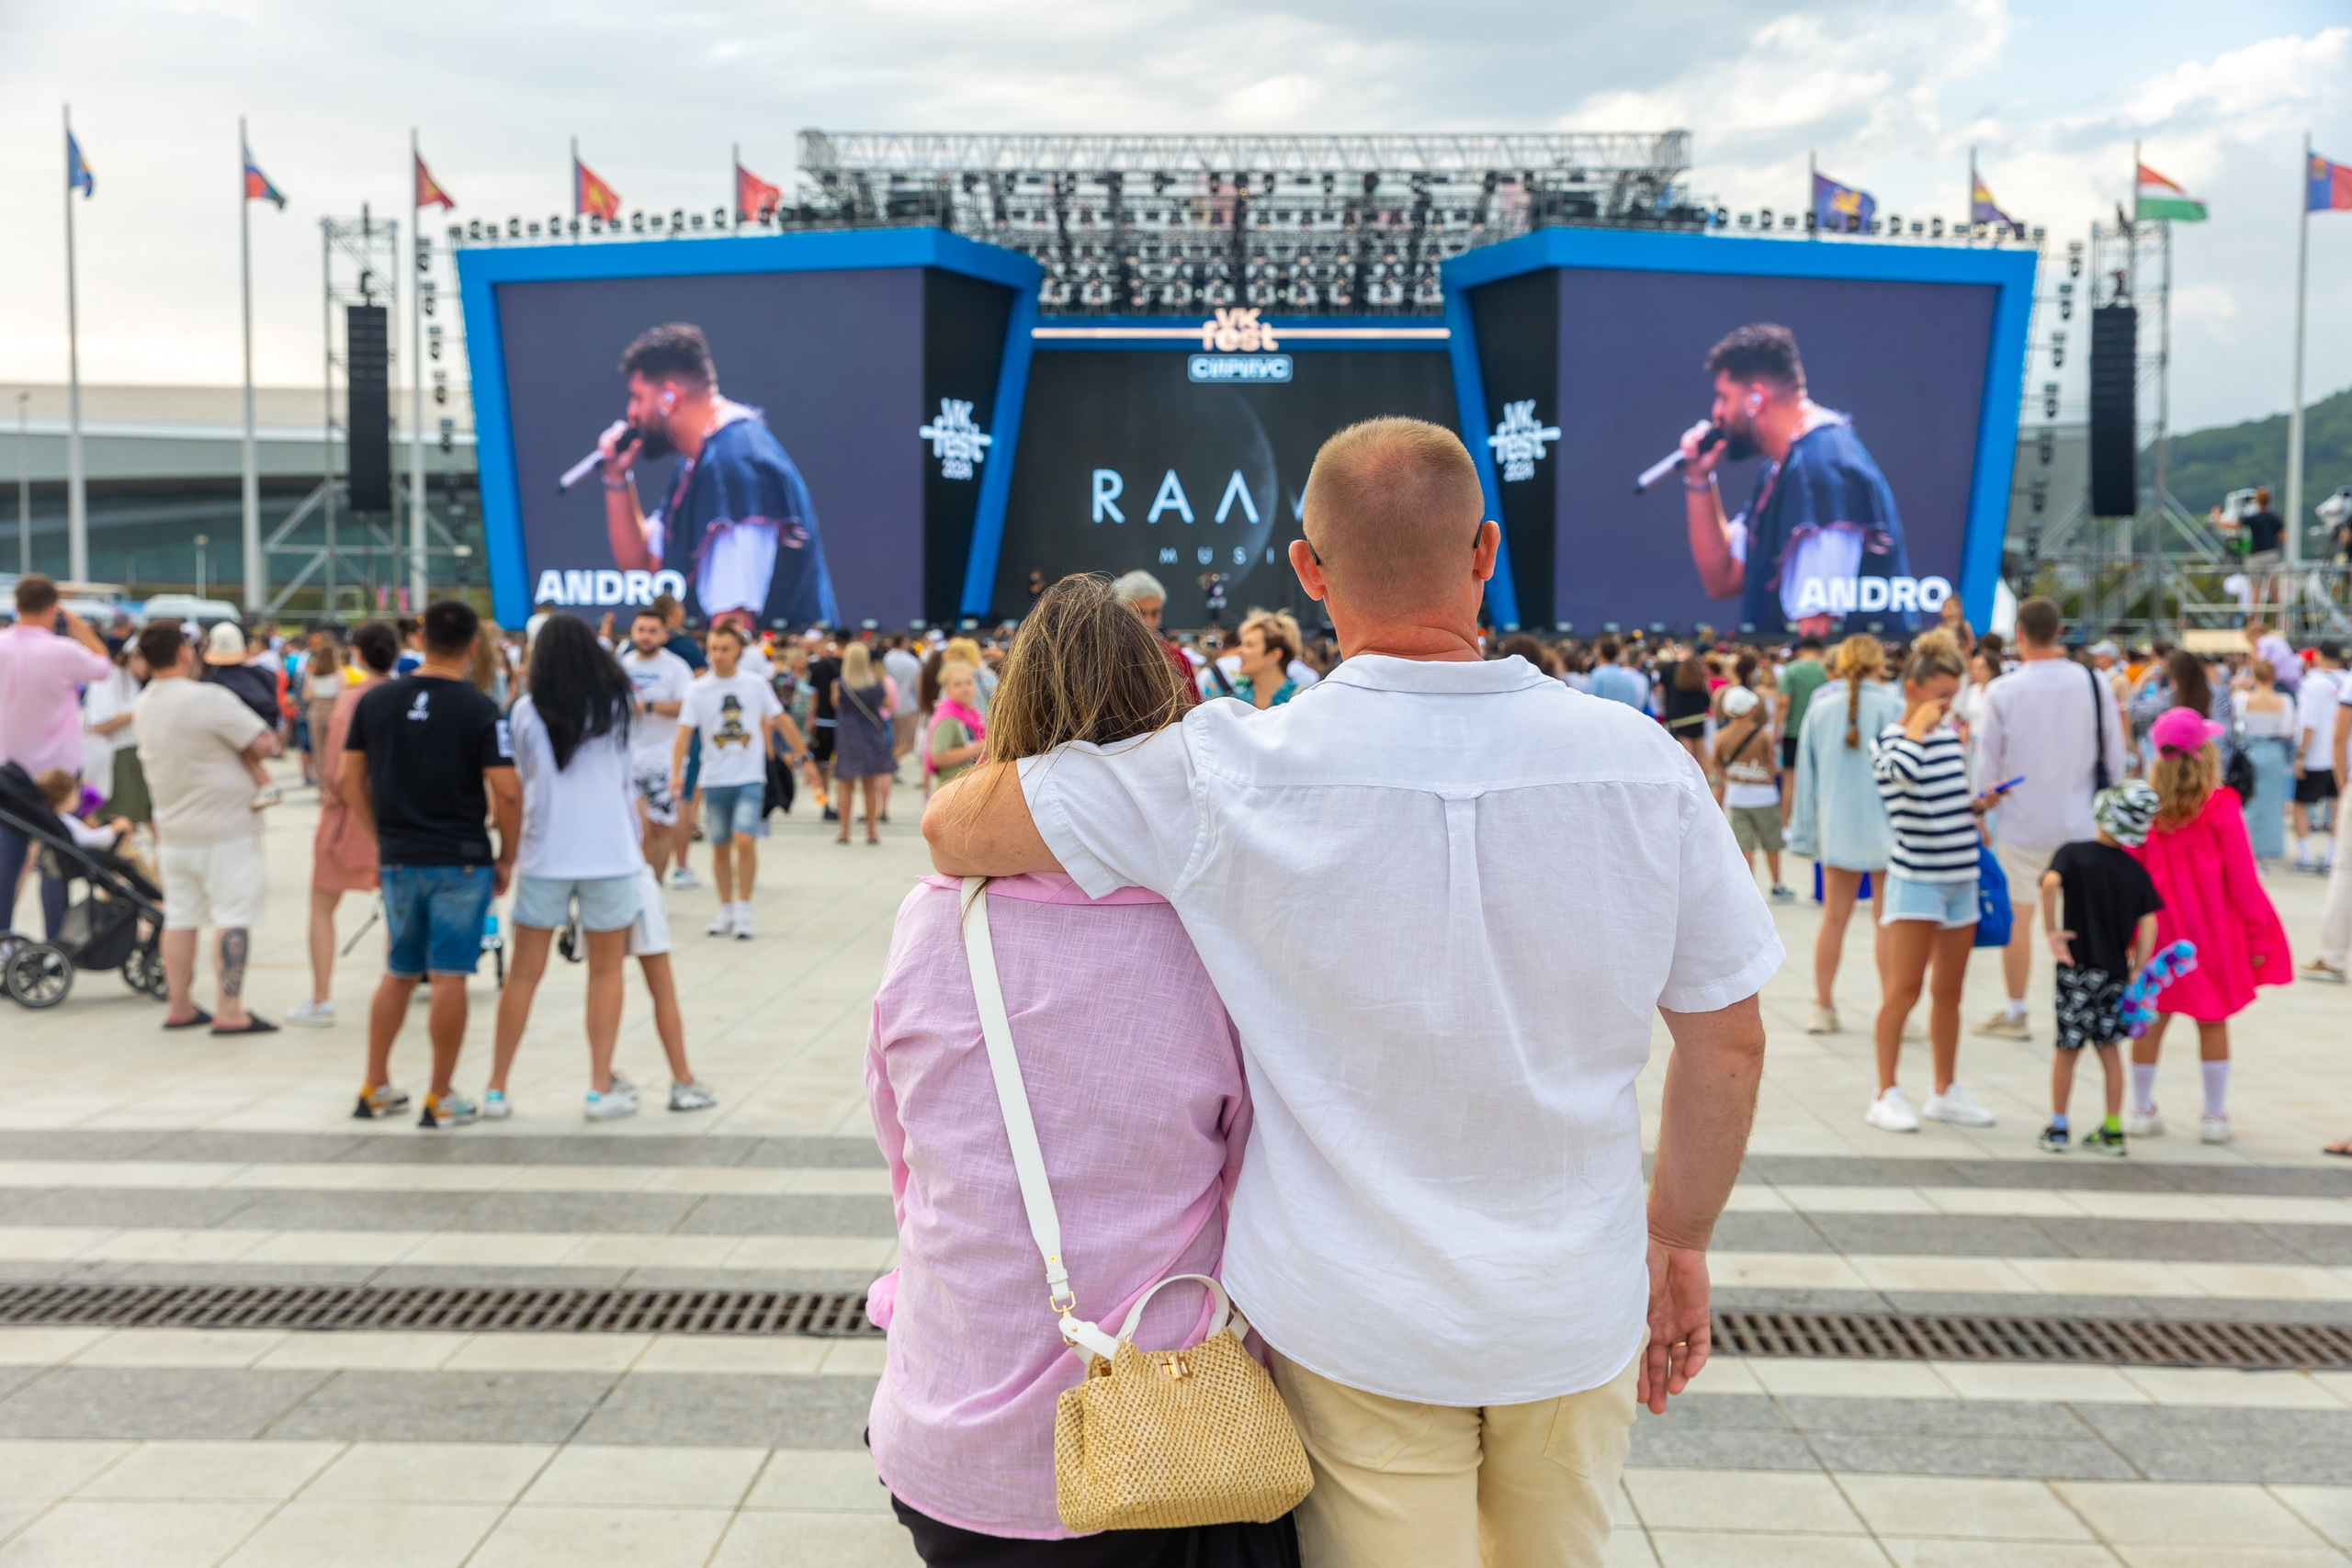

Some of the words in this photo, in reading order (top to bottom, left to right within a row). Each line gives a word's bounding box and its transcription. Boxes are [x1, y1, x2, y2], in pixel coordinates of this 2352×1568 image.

[1158, 546, 1275, 566] MUSI
[535, 569, 687, 606] ANDRO
[1797, 575, 1952, 613] ANDRO
